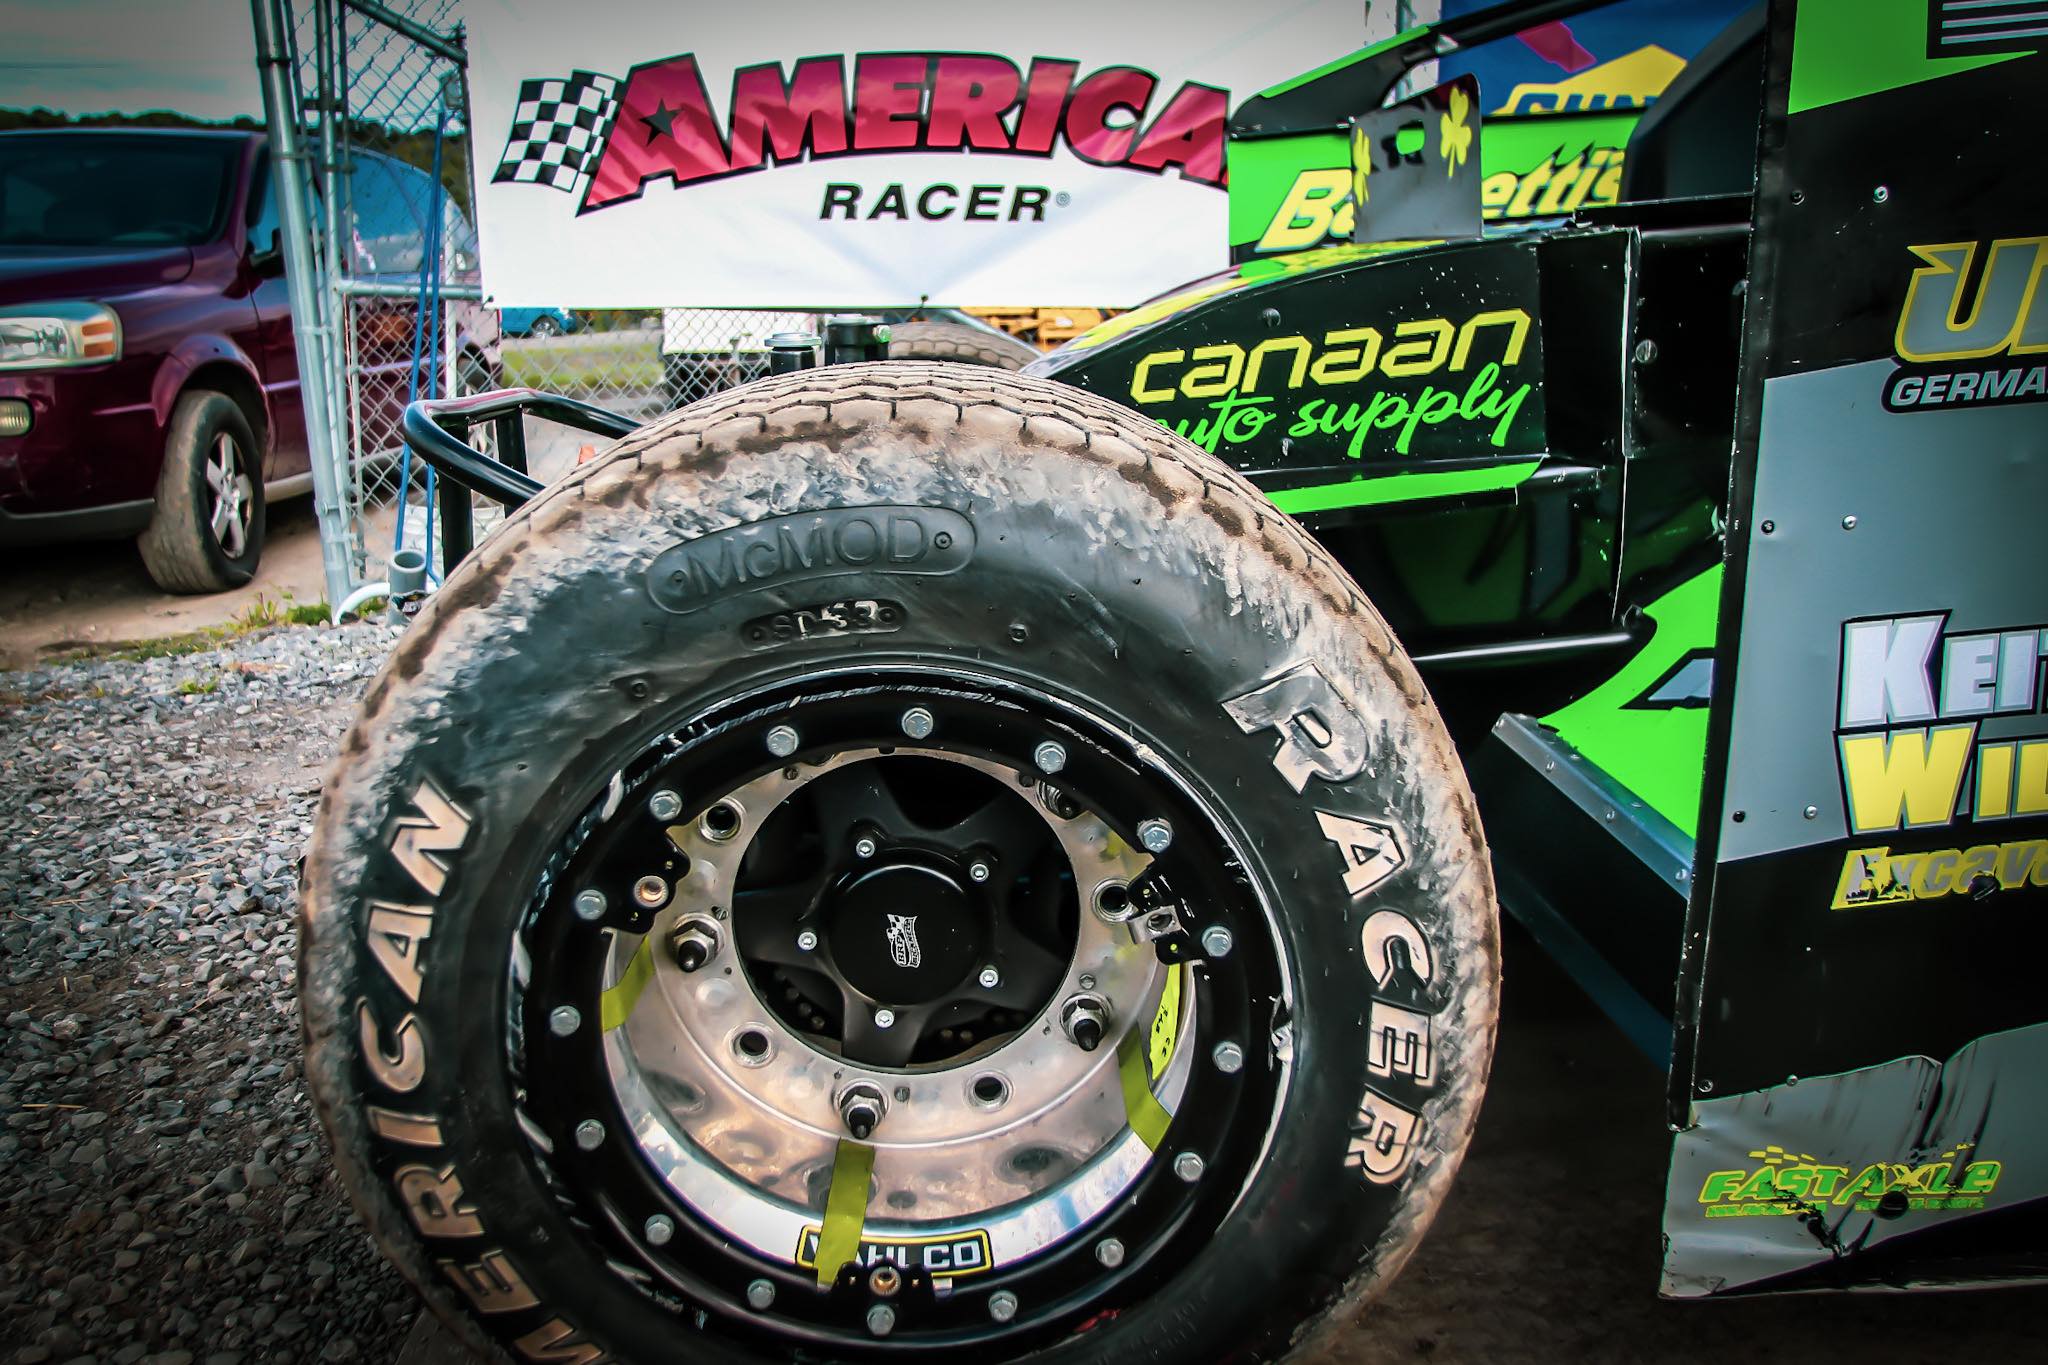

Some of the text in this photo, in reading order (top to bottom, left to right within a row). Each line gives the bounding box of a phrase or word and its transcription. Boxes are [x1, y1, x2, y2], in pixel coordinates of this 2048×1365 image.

[576, 51, 1231, 217] AMERICA
[1130, 308, 1533, 405] canaan
[1890, 366, 2048, 407] GERMA
[1154, 362, 1532, 459] uto supply
[1221, 656, 1434, 1186] RACER
